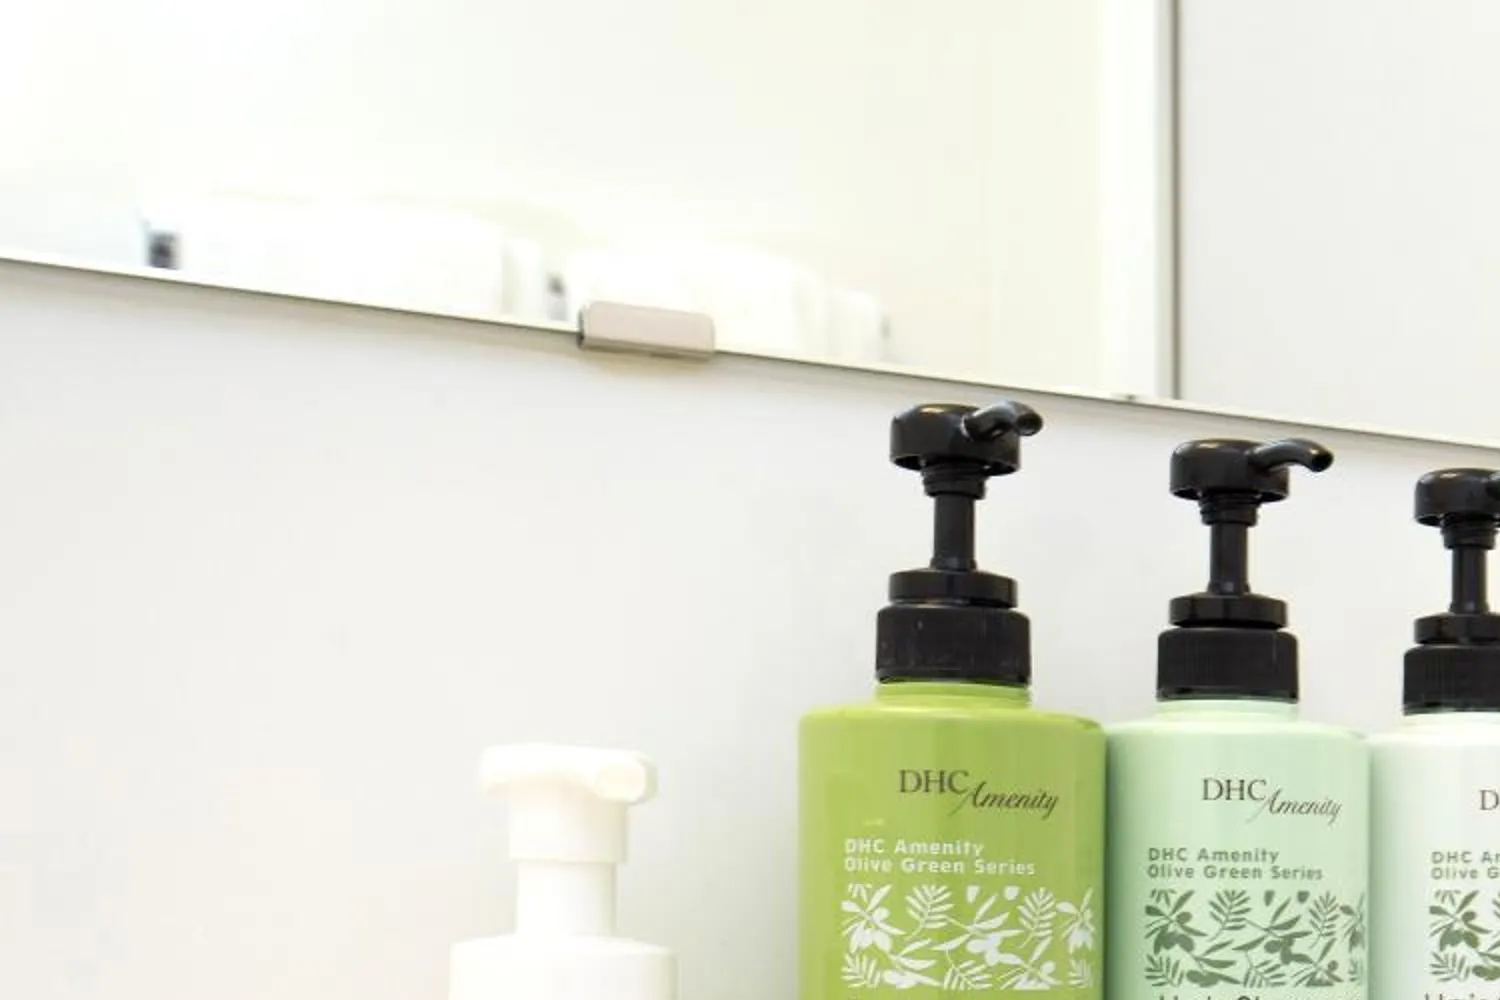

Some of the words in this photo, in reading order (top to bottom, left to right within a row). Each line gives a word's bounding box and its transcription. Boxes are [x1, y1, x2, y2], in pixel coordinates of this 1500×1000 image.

[898, 769, 969, 795] DHC
[947, 780, 1059, 820] Amenity
[1202, 779, 1267, 801] DHC
[1246, 788, 1343, 826] Amenity
[844, 838, 885, 854] DHC
[894, 839, 984, 857] Amenity
[1147, 848, 1187, 862] DHC
[1197, 848, 1279, 864] Amenity
[844, 857, 892, 873] Olive
[901, 858, 965, 874] Green
[975, 859, 1036, 876] Series
[1431, 851, 1472, 864] DHC
[1147, 864, 1194, 879] Olive
[1204, 865, 1263, 879] Green
[1271, 865, 1323, 881] Series
[1431, 867, 1478, 880] Olive
